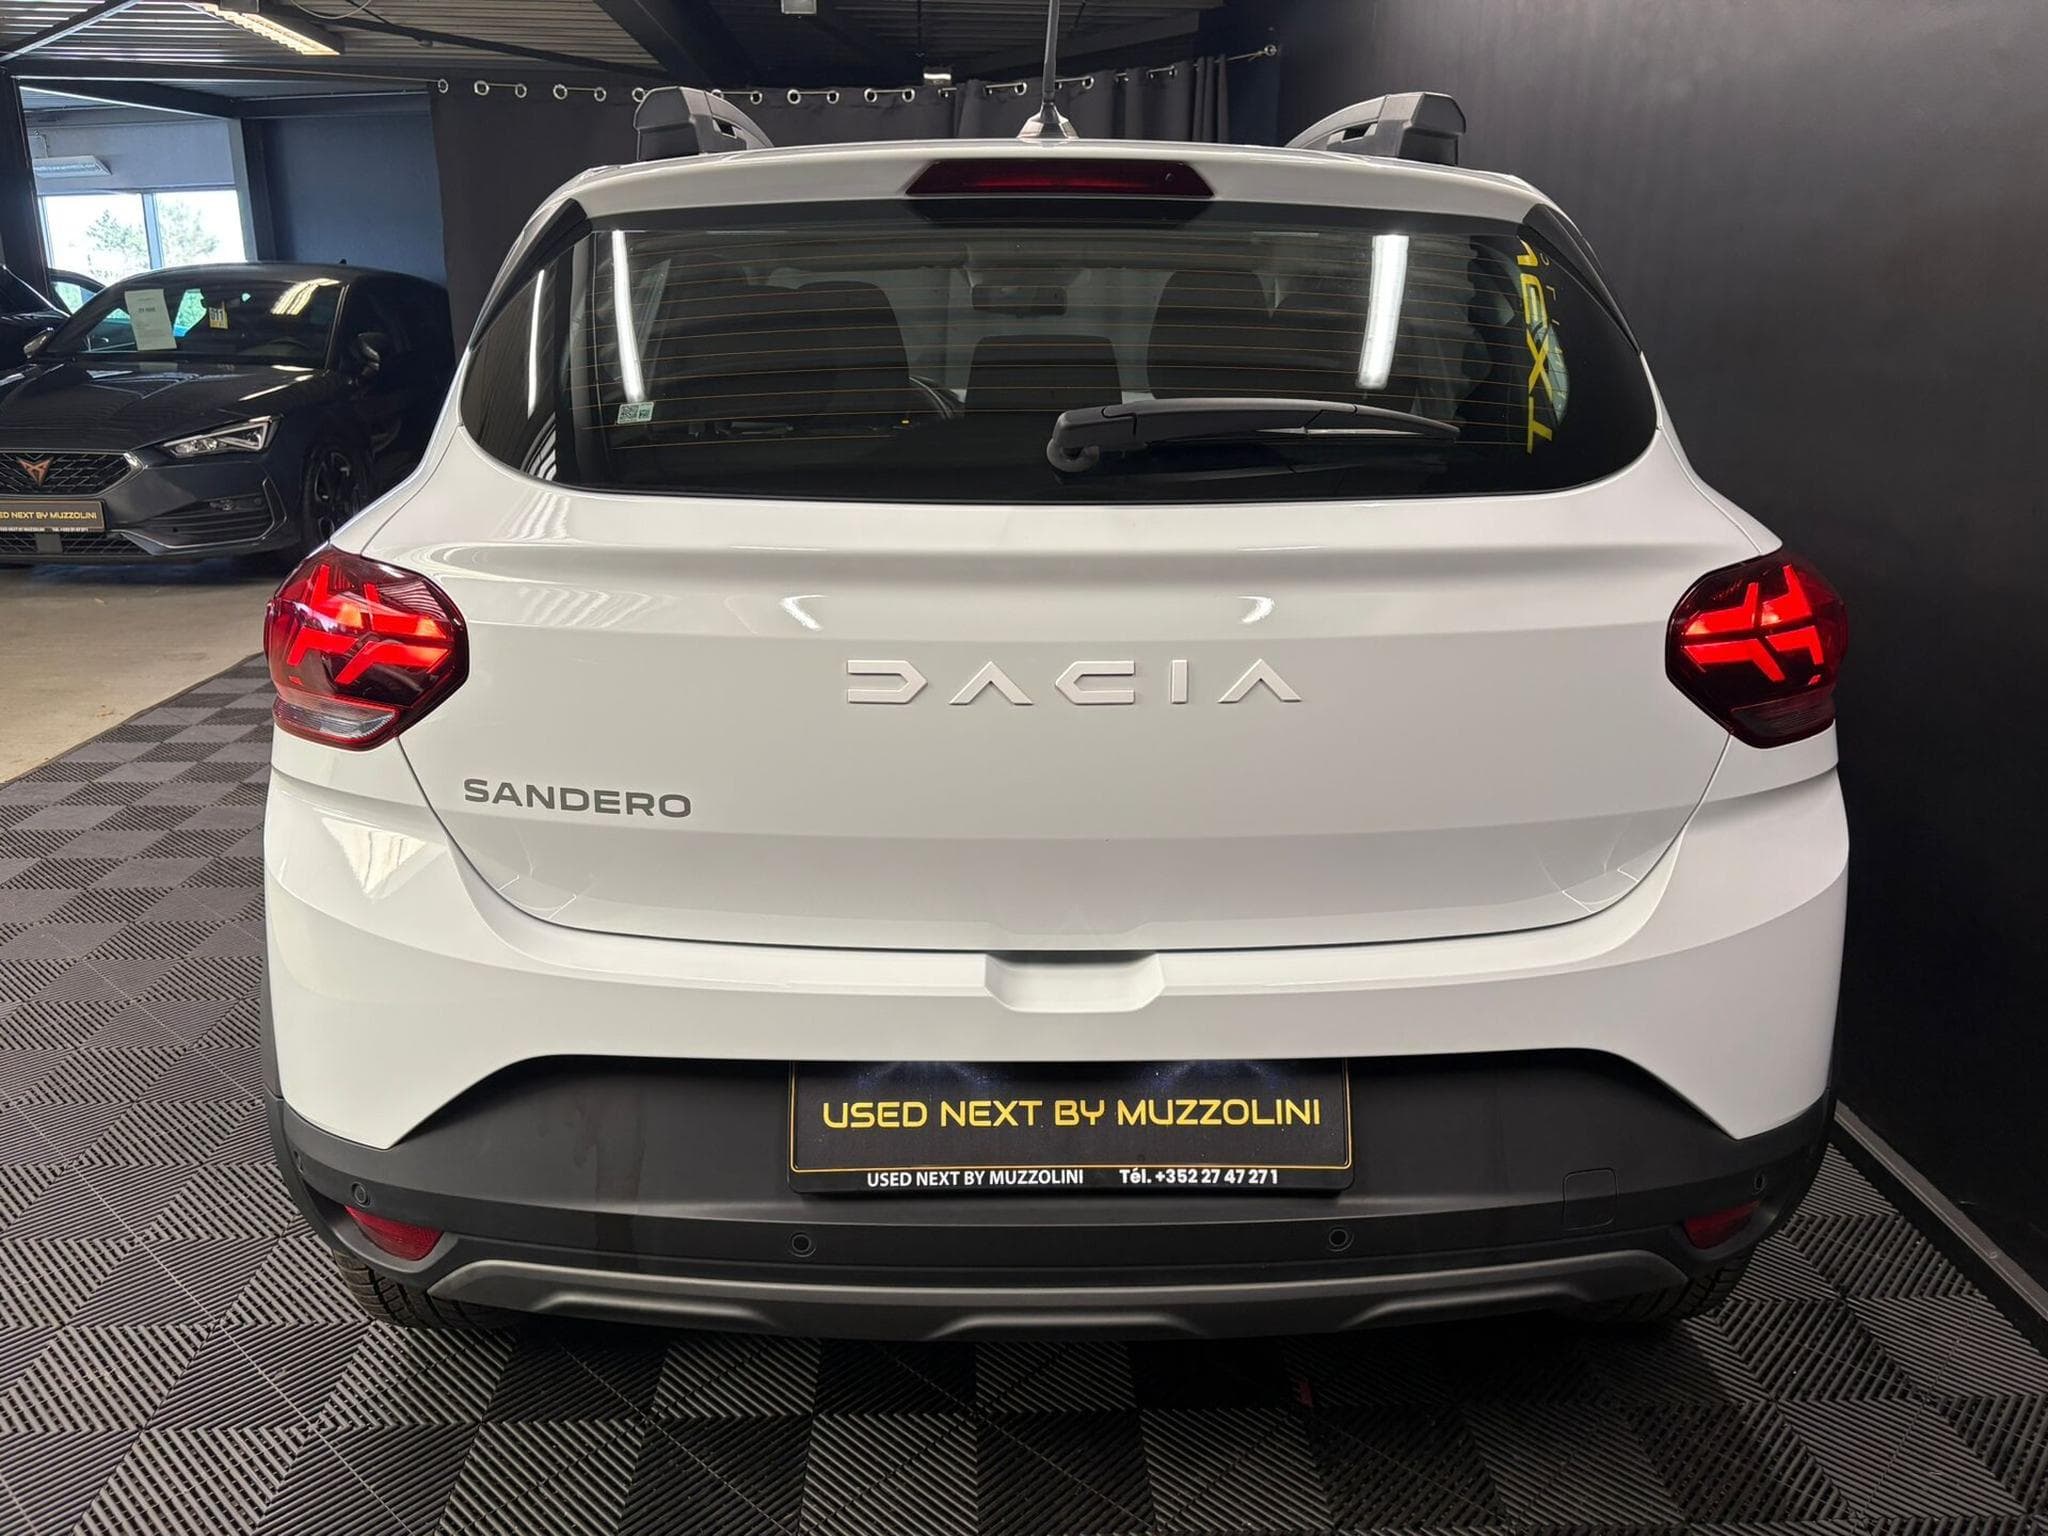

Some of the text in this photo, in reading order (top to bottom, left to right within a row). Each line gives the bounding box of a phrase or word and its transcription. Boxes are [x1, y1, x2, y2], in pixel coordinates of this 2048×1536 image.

[11, 511, 34, 519] NEXT
[36, 511, 48, 519] BY
[50, 511, 97, 519] MUZZOLINI
[846, 658, 1303, 706] DACIA
[463, 778, 692, 818] SANDERO
[822, 1098, 1321, 1129] USED NEXT BY MUZZOLINI
[866, 1169, 1084, 1188] USED NEXT BY MUZZOLINI
[1119, 1167, 1152, 1184] Tél.
[1248, 1169, 1278, 1185] 271
